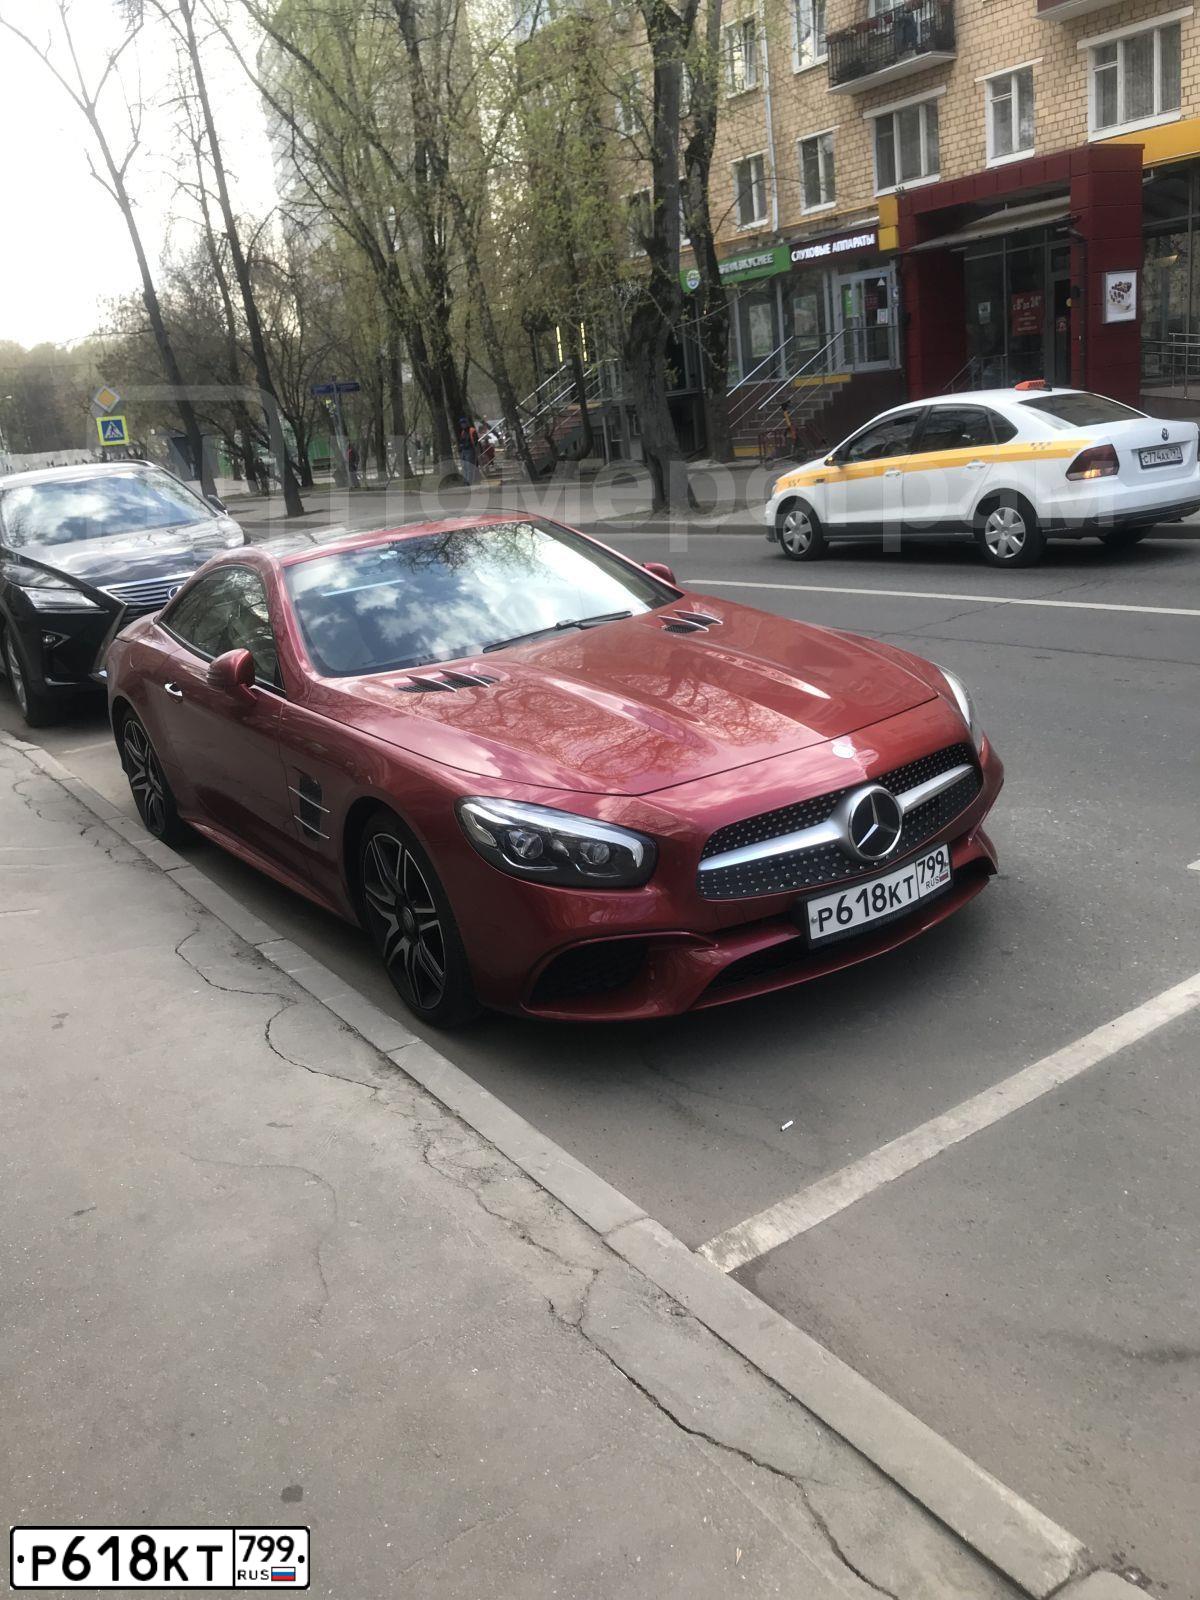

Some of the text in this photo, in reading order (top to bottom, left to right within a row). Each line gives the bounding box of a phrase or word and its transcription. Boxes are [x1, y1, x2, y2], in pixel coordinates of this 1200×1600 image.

[791, 233, 876, 262] СЛУХОВЫЕ АППАРАТЫ
[817, 850, 945, 932] Р618КТ 799
[925, 877, 941, 889] RUS
